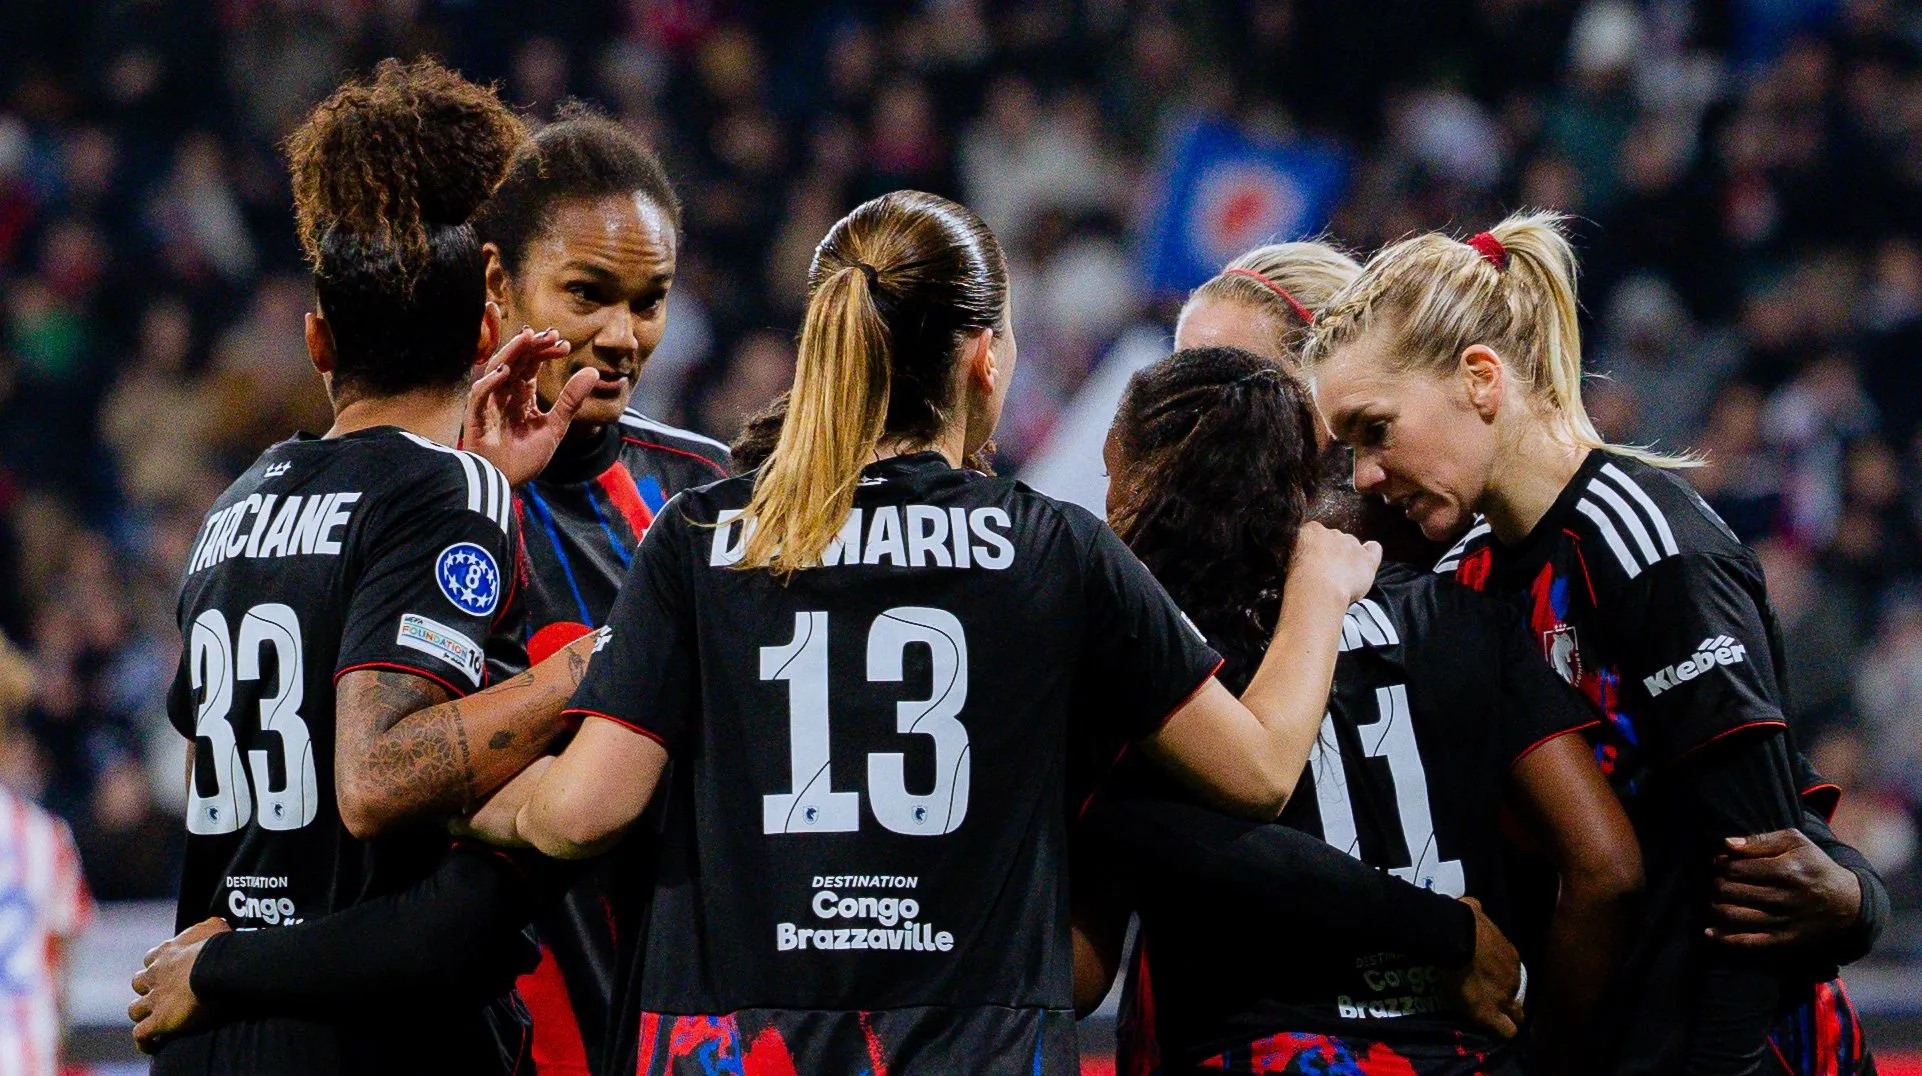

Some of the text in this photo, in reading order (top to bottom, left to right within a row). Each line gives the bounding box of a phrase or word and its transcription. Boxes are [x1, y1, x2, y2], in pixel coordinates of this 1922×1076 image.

[188, 491, 363, 575] TARCIANE
[710, 504, 1016, 570] DMARIS
[465, 564, 482, 589] 8
[402, 625, 468, 658] FOUNDATION
[1643, 643, 1746, 697] Kleber
[186, 603, 319, 835] 33
[759, 606, 971, 836] 13
[1308, 684, 1466, 899] 11
[812, 876, 919, 889] DESTINATION
[812, 890, 920, 927] Congo
[777, 921, 955, 951] Brazzaville
